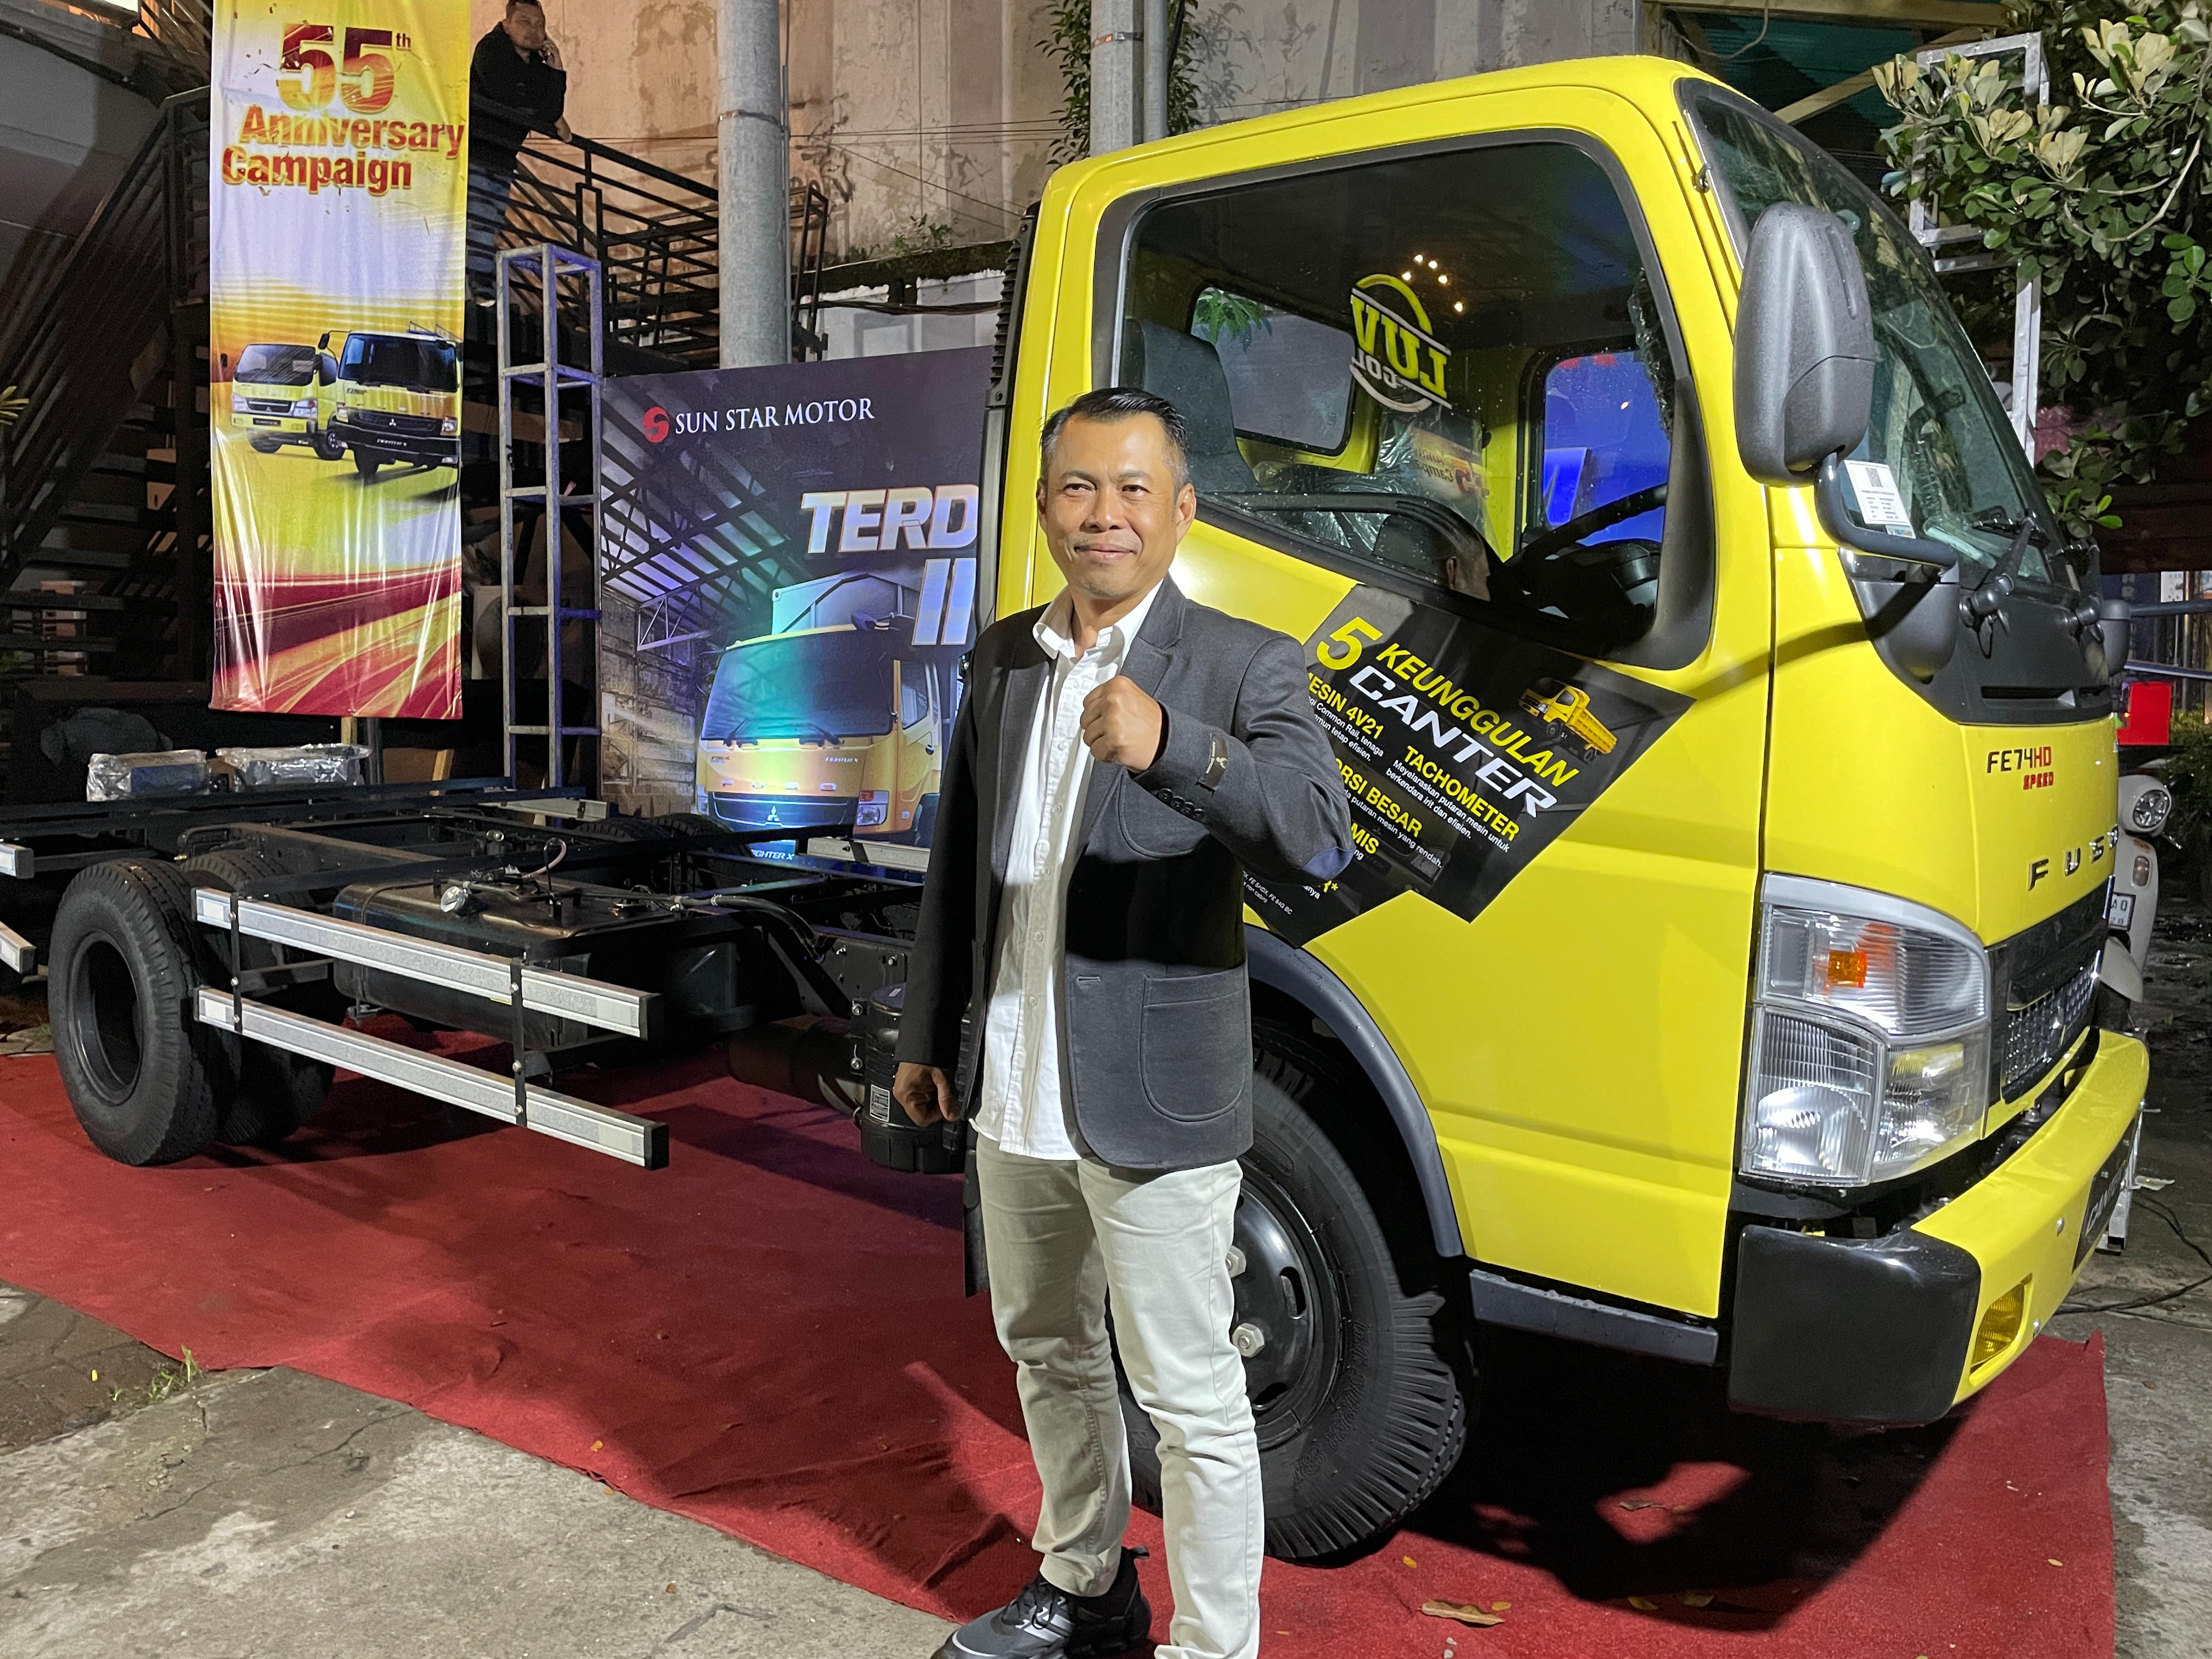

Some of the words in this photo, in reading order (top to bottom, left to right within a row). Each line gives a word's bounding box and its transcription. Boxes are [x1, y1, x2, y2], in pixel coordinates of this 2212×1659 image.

[239, 105, 465, 160] Anniversary
[221, 145, 412, 197] Campaign
[674, 411, 718, 435] SUN
[725, 405, 780, 431] STAR
[784, 398, 875, 426] MOTOR
[800, 484, 979, 554] TERD
[1317, 616, 1383, 670] 5
[1317, 702, 1346, 728] Common
[1345, 724, 1360, 740] Rail,
[1361, 736, 1384, 757] tenaga
[1346, 707, 1384, 740] 4V21
[1349, 665, 1558, 818] CANTER
[1375, 642, 1579, 788] KEUNGGULAN
[1331, 726, 1348, 743] tetap
[1348, 741, 1371, 761] efisien.
[1986, 746, 2052, 773] FE74HD
[1386, 768, 1424, 800] berkendara
[1423, 797, 1435, 809] irit
[1433, 805, 1448, 820] dan
[1447, 816, 1472, 839] efisien.
[1404, 745, 1520, 842] TACHOMETER
[2023, 771, 2054, 791] SPEED
[1351, 796, 1377, 819] putaran
[1377, 816, 1398, 834] mesin
[1397, 831, 1417, 849] yang
[1416, 845, 1442, 868] rendah.
[1351, 822, 1379, 854] MIS
[1365, 786, 1423, 838] BESAR
[1438, 795, 1467, 820] putaran
[1466, 816, 1488, 837] mesin
[1488, 834, 1510, 853] untuk
[751, 849, 786, 860] GHTER
